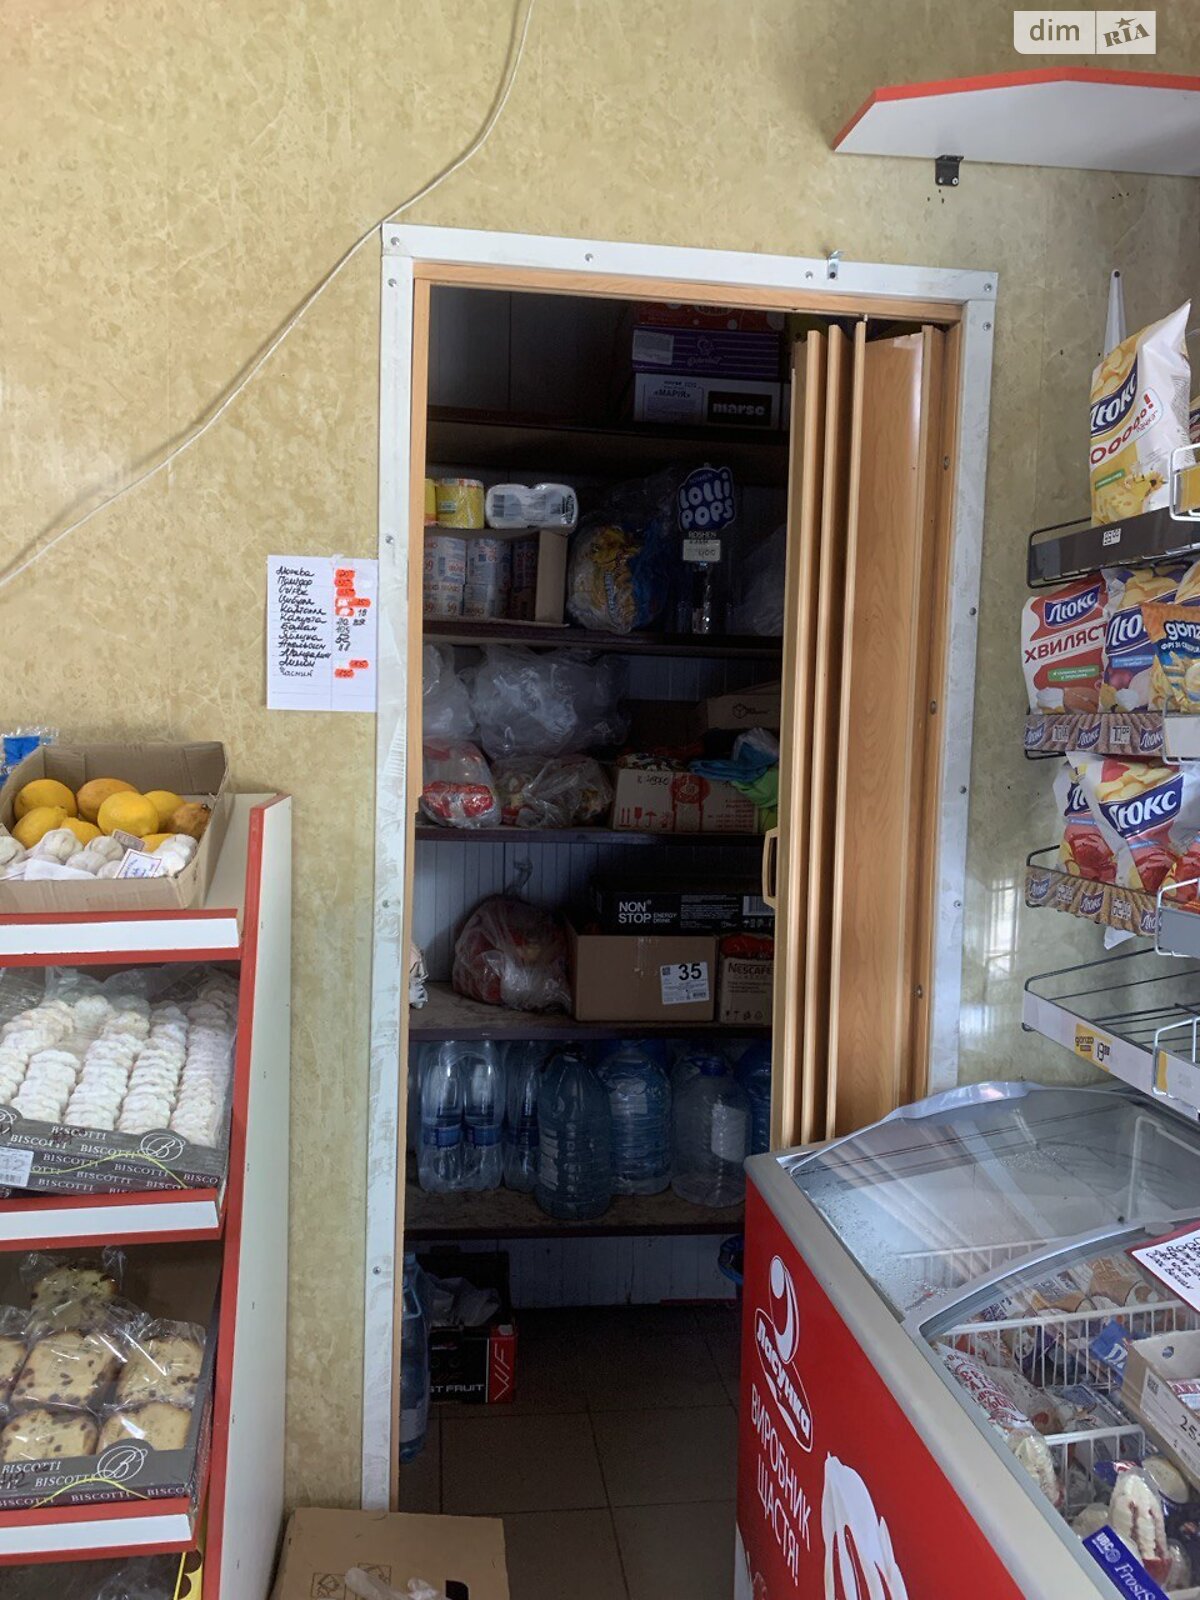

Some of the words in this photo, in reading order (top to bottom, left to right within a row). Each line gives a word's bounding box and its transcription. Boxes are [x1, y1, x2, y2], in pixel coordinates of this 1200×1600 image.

[681, 498, 733, 529] POPS
[1046, 592, 1097, 624] Люкс
[1109, 614, 1147, 647] Лю
[618, 913, 652, 924] STOP
[678, 963, 702, 981] 35
[38, 1178, 94, 1192] BISCOTTI
[76, 1171, 131, 1185] BISCOTTI
[446, 1383, 485, 1393] FRUIT
[751, 1383, 812, 1553] ВИРОБНИК
[758, 1453, 799, 1587] ЩАСТЯ!
